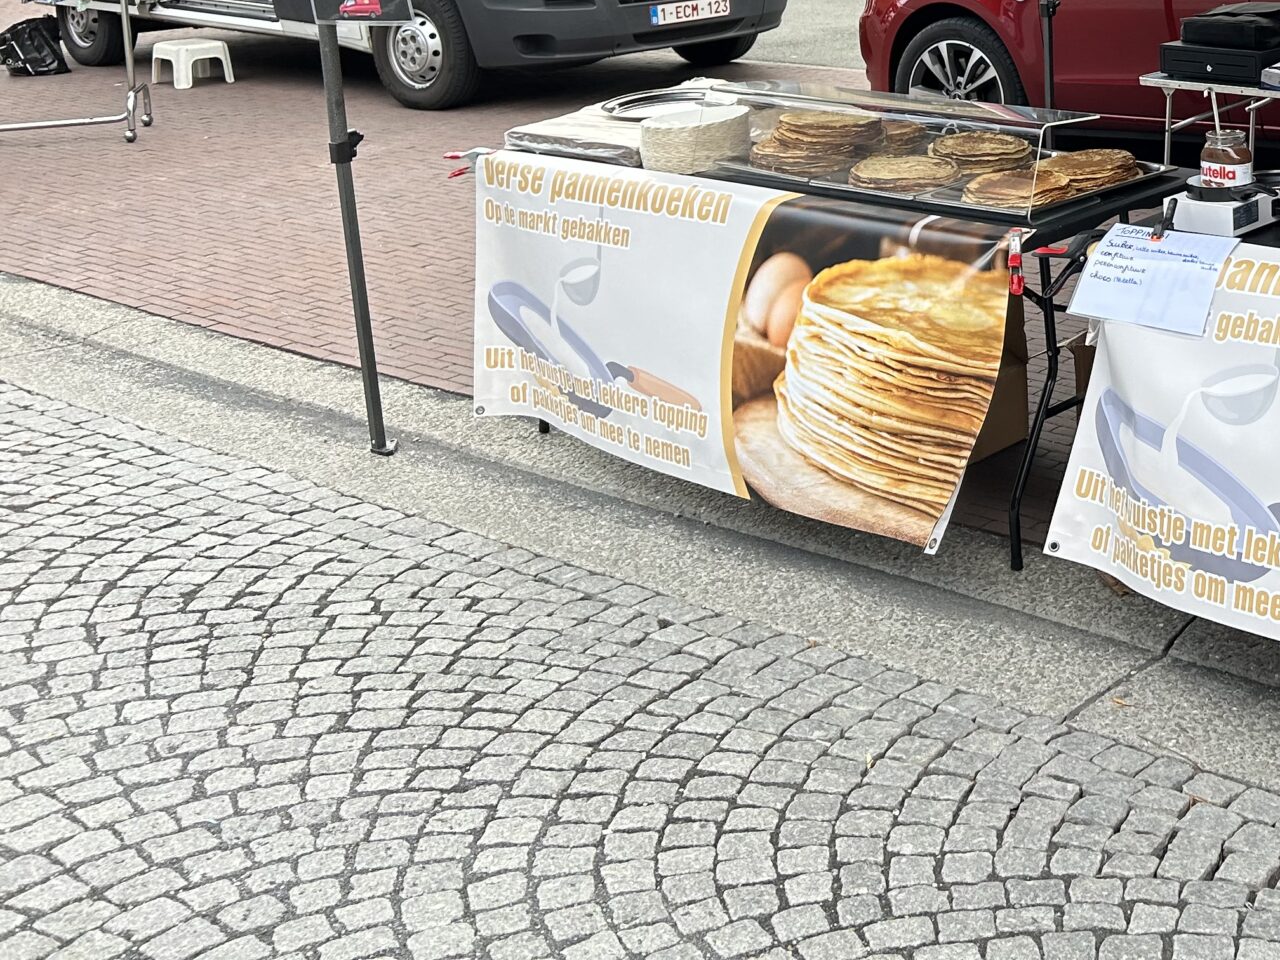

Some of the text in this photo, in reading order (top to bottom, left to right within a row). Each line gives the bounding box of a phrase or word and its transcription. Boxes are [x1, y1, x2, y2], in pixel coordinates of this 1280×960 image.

[660, 0, 729, 21] 1-ECM-123
[484, 156, 733, 225] Verse pannenkoeken
[1201, 166, 1237, 181] utella
[484, 198, 631, 248] Op de markt gebakken
[485, 347, 708, 438] Uit het vuistje met lekkere topping
[510, 382, 691, 467] of pakketjes om mee te nemen
[1075, 468, 1107, 504] Uit
[1108, 478, 1128, 516] het
[1126, 496, 1186, 544] vuistje
[1191, 520, 1238, 556] met
[1092, 525, 1111, 554] of
[1112, 536, 1186, 592] pakketjes
[1193, 570, 1227, 604] om
